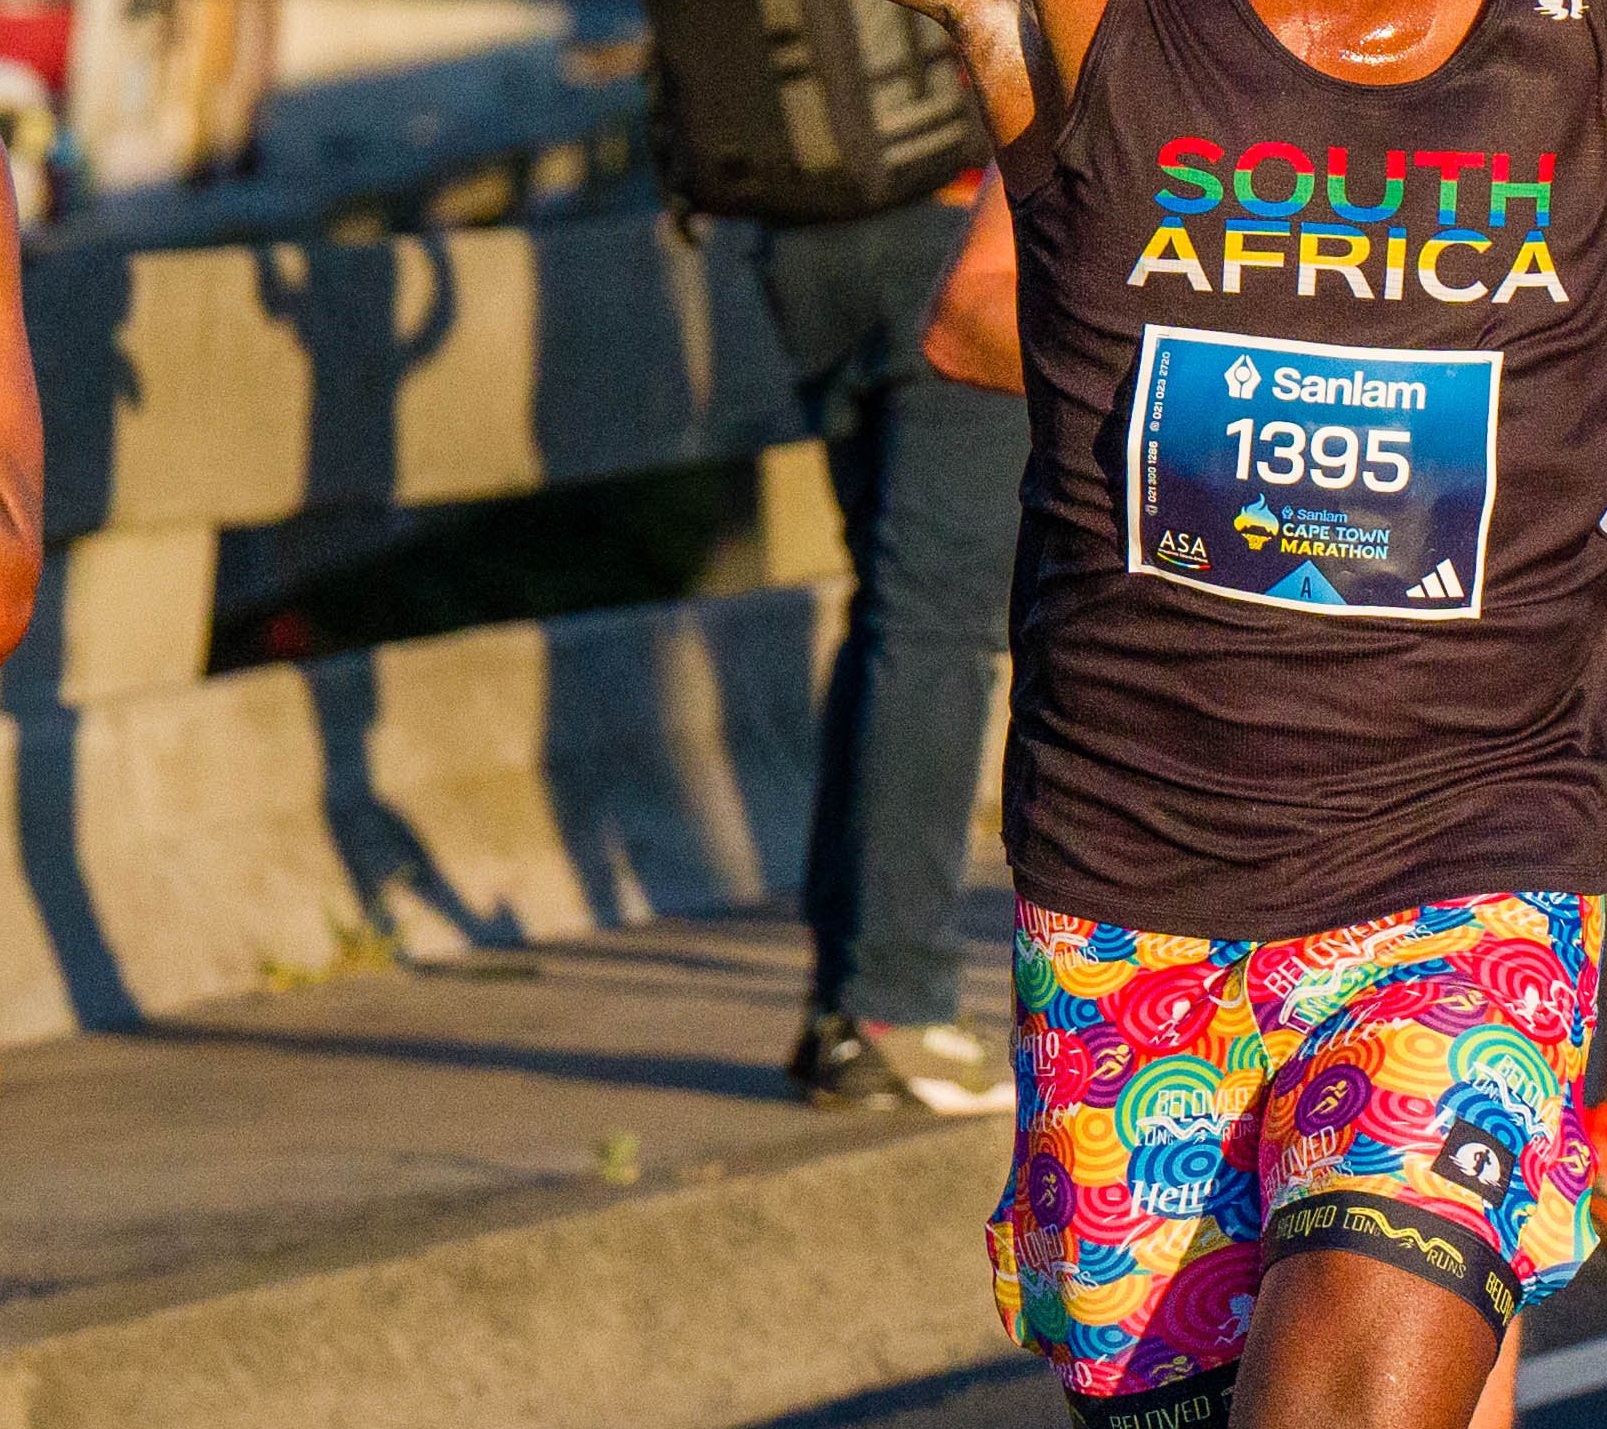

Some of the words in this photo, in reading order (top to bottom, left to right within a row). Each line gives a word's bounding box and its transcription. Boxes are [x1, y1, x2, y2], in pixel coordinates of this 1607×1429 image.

[1154, 136, 1557, 227] SOUTH
[1127, 216, 1570, 305] AFRICA
[1272, 367, 1426, 410] Sanlam
[1226, 418, 1411, 493] 1395
[1297, 508, 1348, 523] Sanlam
[1159, 529, 1208, 558] ASA
[1280, 539, 1389, 560] MARATHON
[1282, 523, 1330, 541] CAPE
[1336, 526, 1390, 544] TOWN
[1300, 576, 1312, 599] A
[1157, 1087, 1248, 1122] BELOVED
[1277, 1205, 1338, 1239] BELOVED
[1426, 1250, 1466, 1280] RUNS
